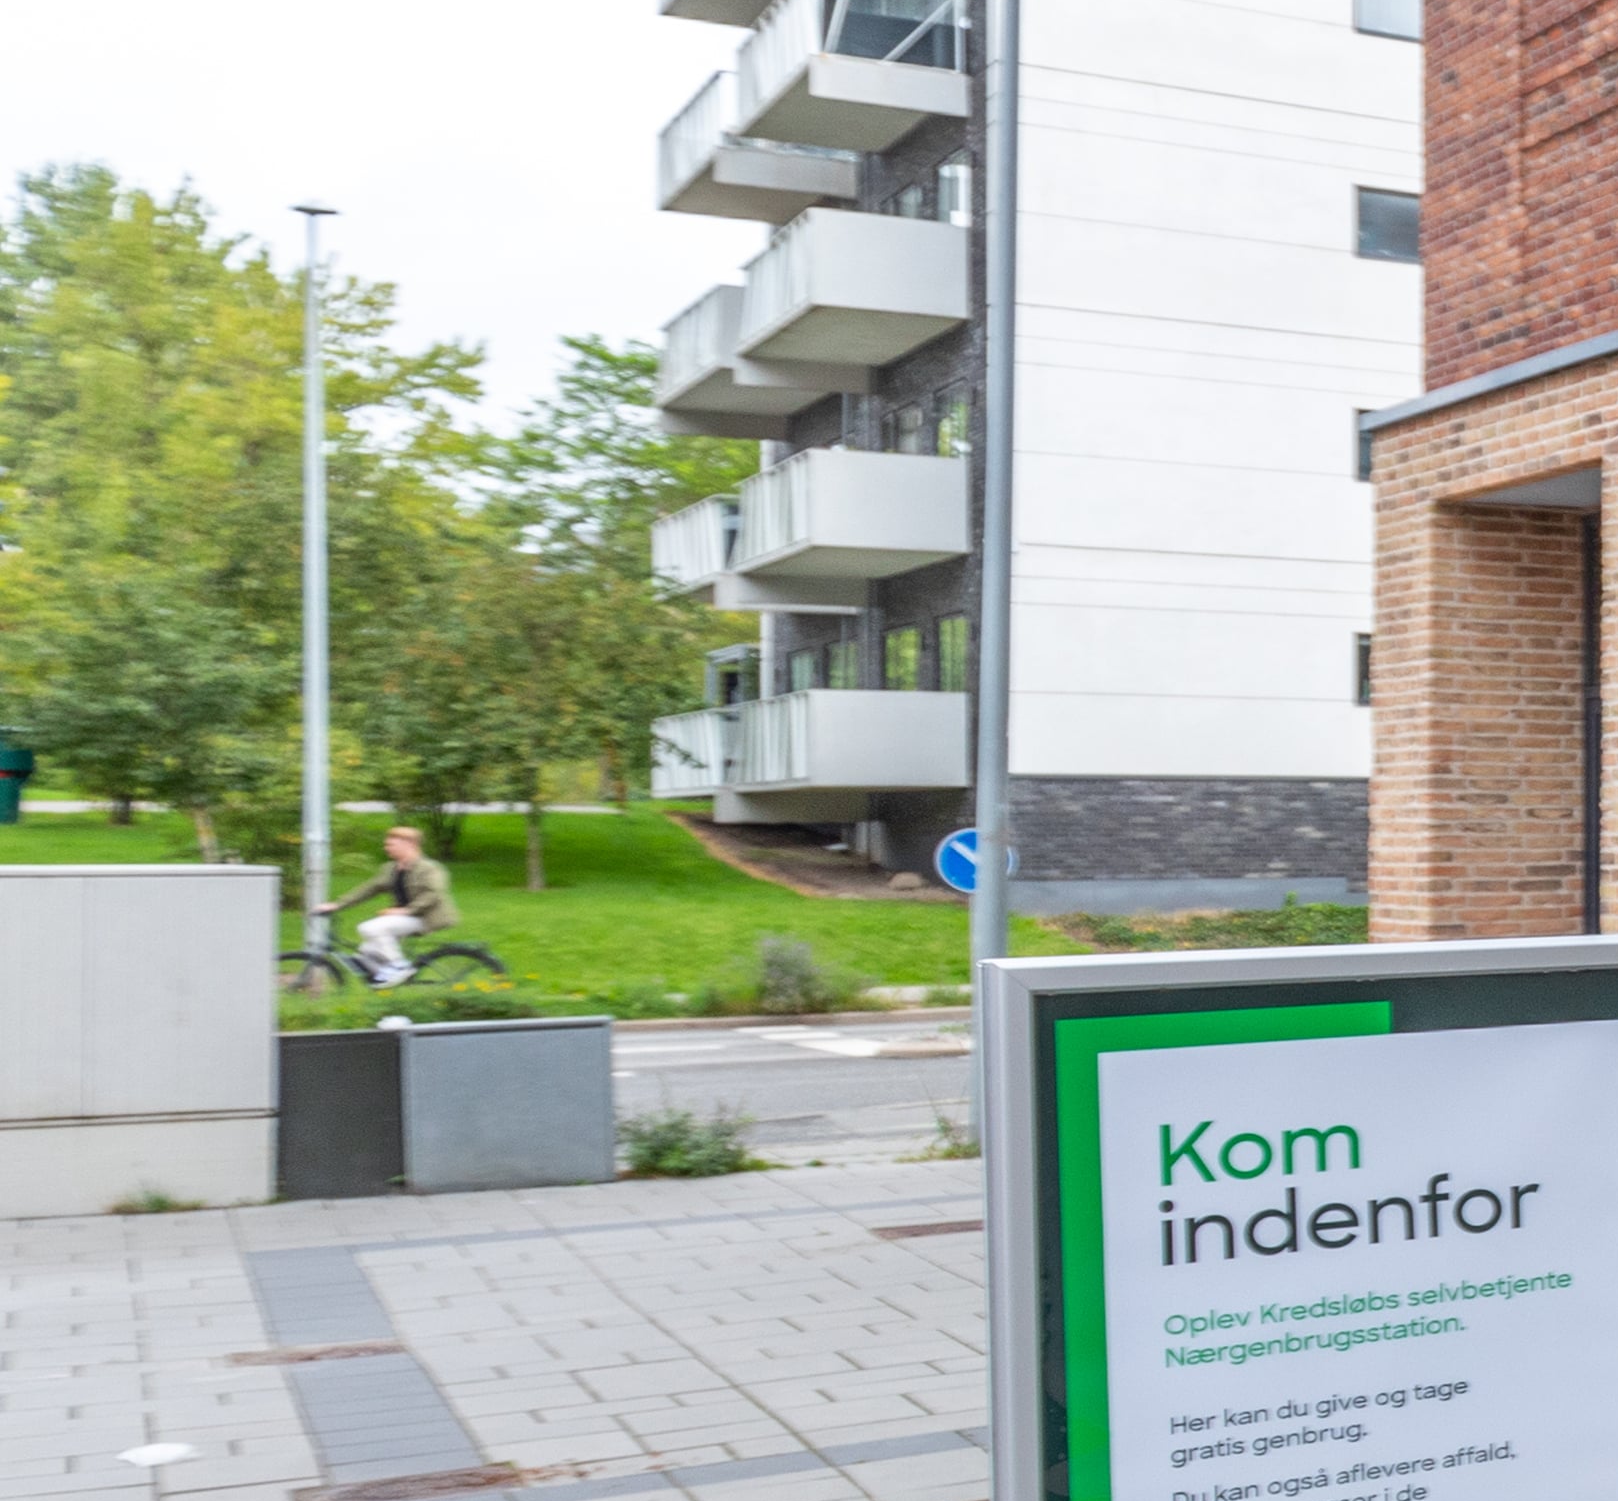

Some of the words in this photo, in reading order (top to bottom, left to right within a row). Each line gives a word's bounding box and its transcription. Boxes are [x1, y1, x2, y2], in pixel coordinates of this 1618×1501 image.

[1159, 1121, 1360, 1186] Kom
[1158, 1172, 1540, 1266] indenfor
[1163, 1307, 1252, 1339] Oplev
[1260, 1292, 1400, 1325] Kredsløbs
[1407, 1271, 1572, 1306] selvbetjente
[1165, 1316, 1466, 1367] Nærgenbrugsstation.
[1170, 1414, 1216, 1435] Her
[1224, 1407, 1269, 1428] kan
[1276, 1400, 1308, 1420] du
[1315, 1394, 1368, 1418] give
[1374, 1390, 1407, 1409] og
[1413, 1380, 1469, 1402] tage
[1170, 1437, 1245, 1468] gratis
[1252, 1421, 1369, 1455] genbrug.
[1267, 1468, 1330, 1498] også
[1335, 1457, 1436, 1487] aflevere
[1441, 1441, 1517, 1470] affald,
